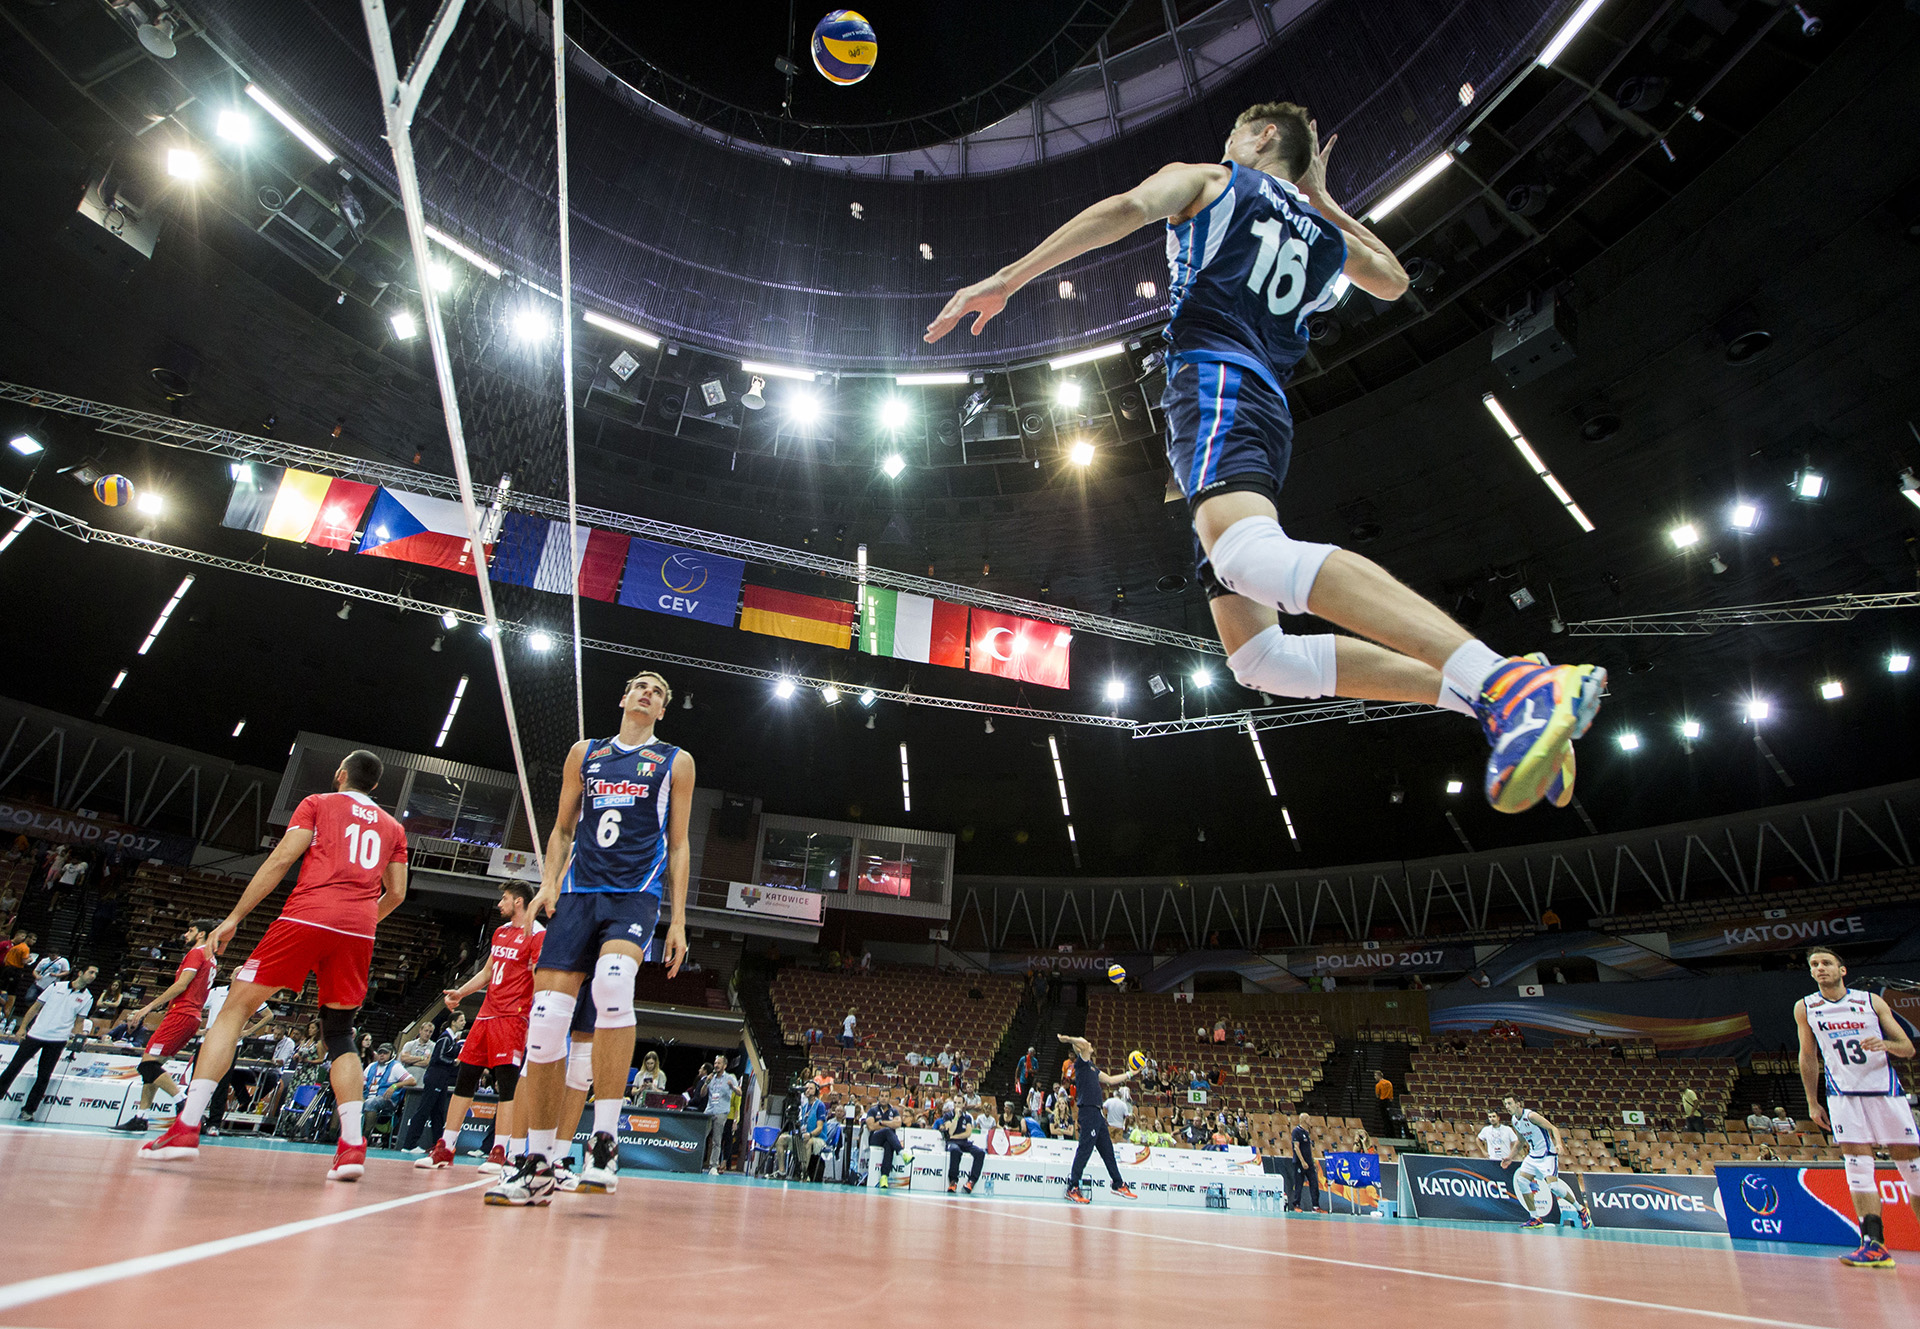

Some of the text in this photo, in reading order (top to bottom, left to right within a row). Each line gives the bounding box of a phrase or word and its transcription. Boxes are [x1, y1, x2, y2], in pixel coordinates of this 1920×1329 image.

[1250, 217, 1308, 315] 16
[658, 594, 699, 613] CEV
[587, 778, 648, 797] Kinder
[0, 804, 161, 851] POLAND 2017
[597, 809, 622, 848] 6
[345, 823, 381, 869] 10
[766, 892, 809, 905] KATOWICE
[1723, 916, 1865, 945] KATOWICE
[491, 945, 519, 960] VESTEL
[1316, 950, 1444, 969] POLAND 2017
[1027, 955, 1115, 971] KATOWICE
[492, 961, 506, 985] 16
[1526, 986, 1536, 996] C
[1818, 1020, 1866, 1031] Kinder
[1832, 1039, 1867, 1065] 13
[924, 1073, 934, 1084] A
[1193, 1091, 1201, 1102] B
[1628, 1112, 1639, 1123] C
[648, 1138, 680, 1148] POLAND
[681, 1141, 698, 1149] 2017
[1417, 1176, 1510, 1199] KATOWICE
[1592, 1191, 1706, 1212] KATOWICE
[1751, 1218, 1782, 1234] CEV
